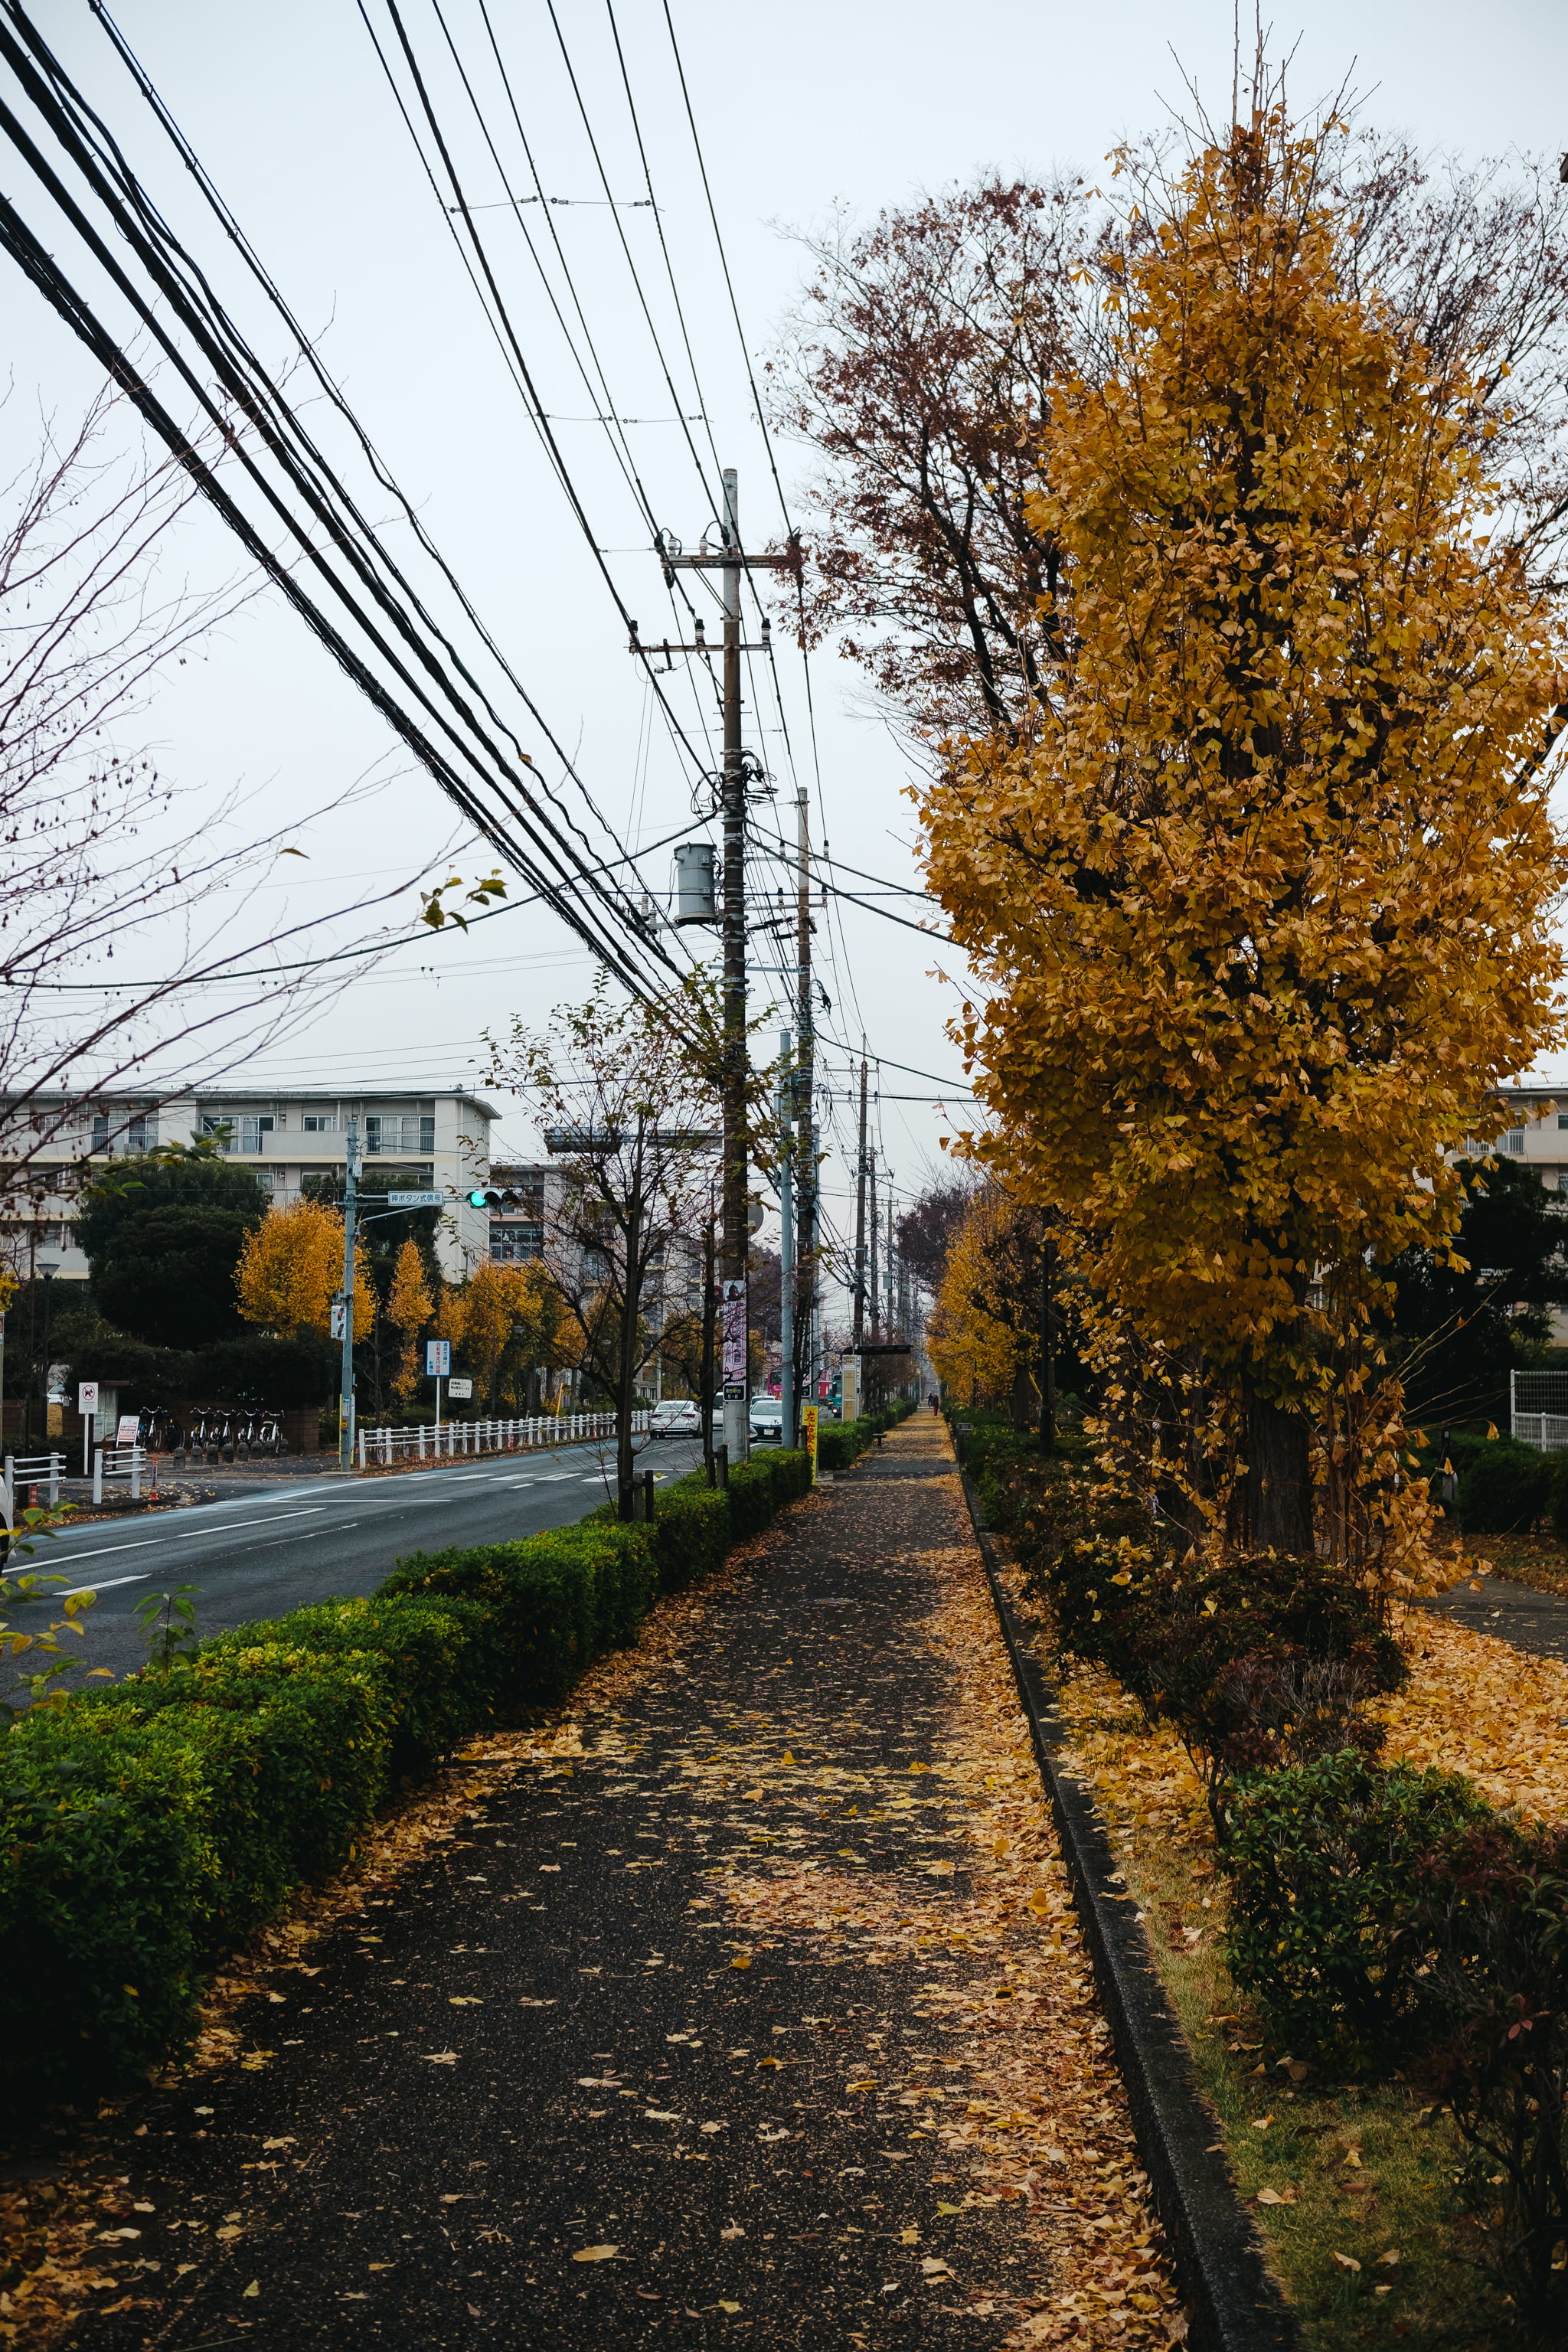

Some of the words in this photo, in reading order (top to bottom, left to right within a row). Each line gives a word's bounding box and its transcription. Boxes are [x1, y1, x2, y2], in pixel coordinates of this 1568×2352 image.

[391, 1194, 441, 1203] 押ボタン式信号
